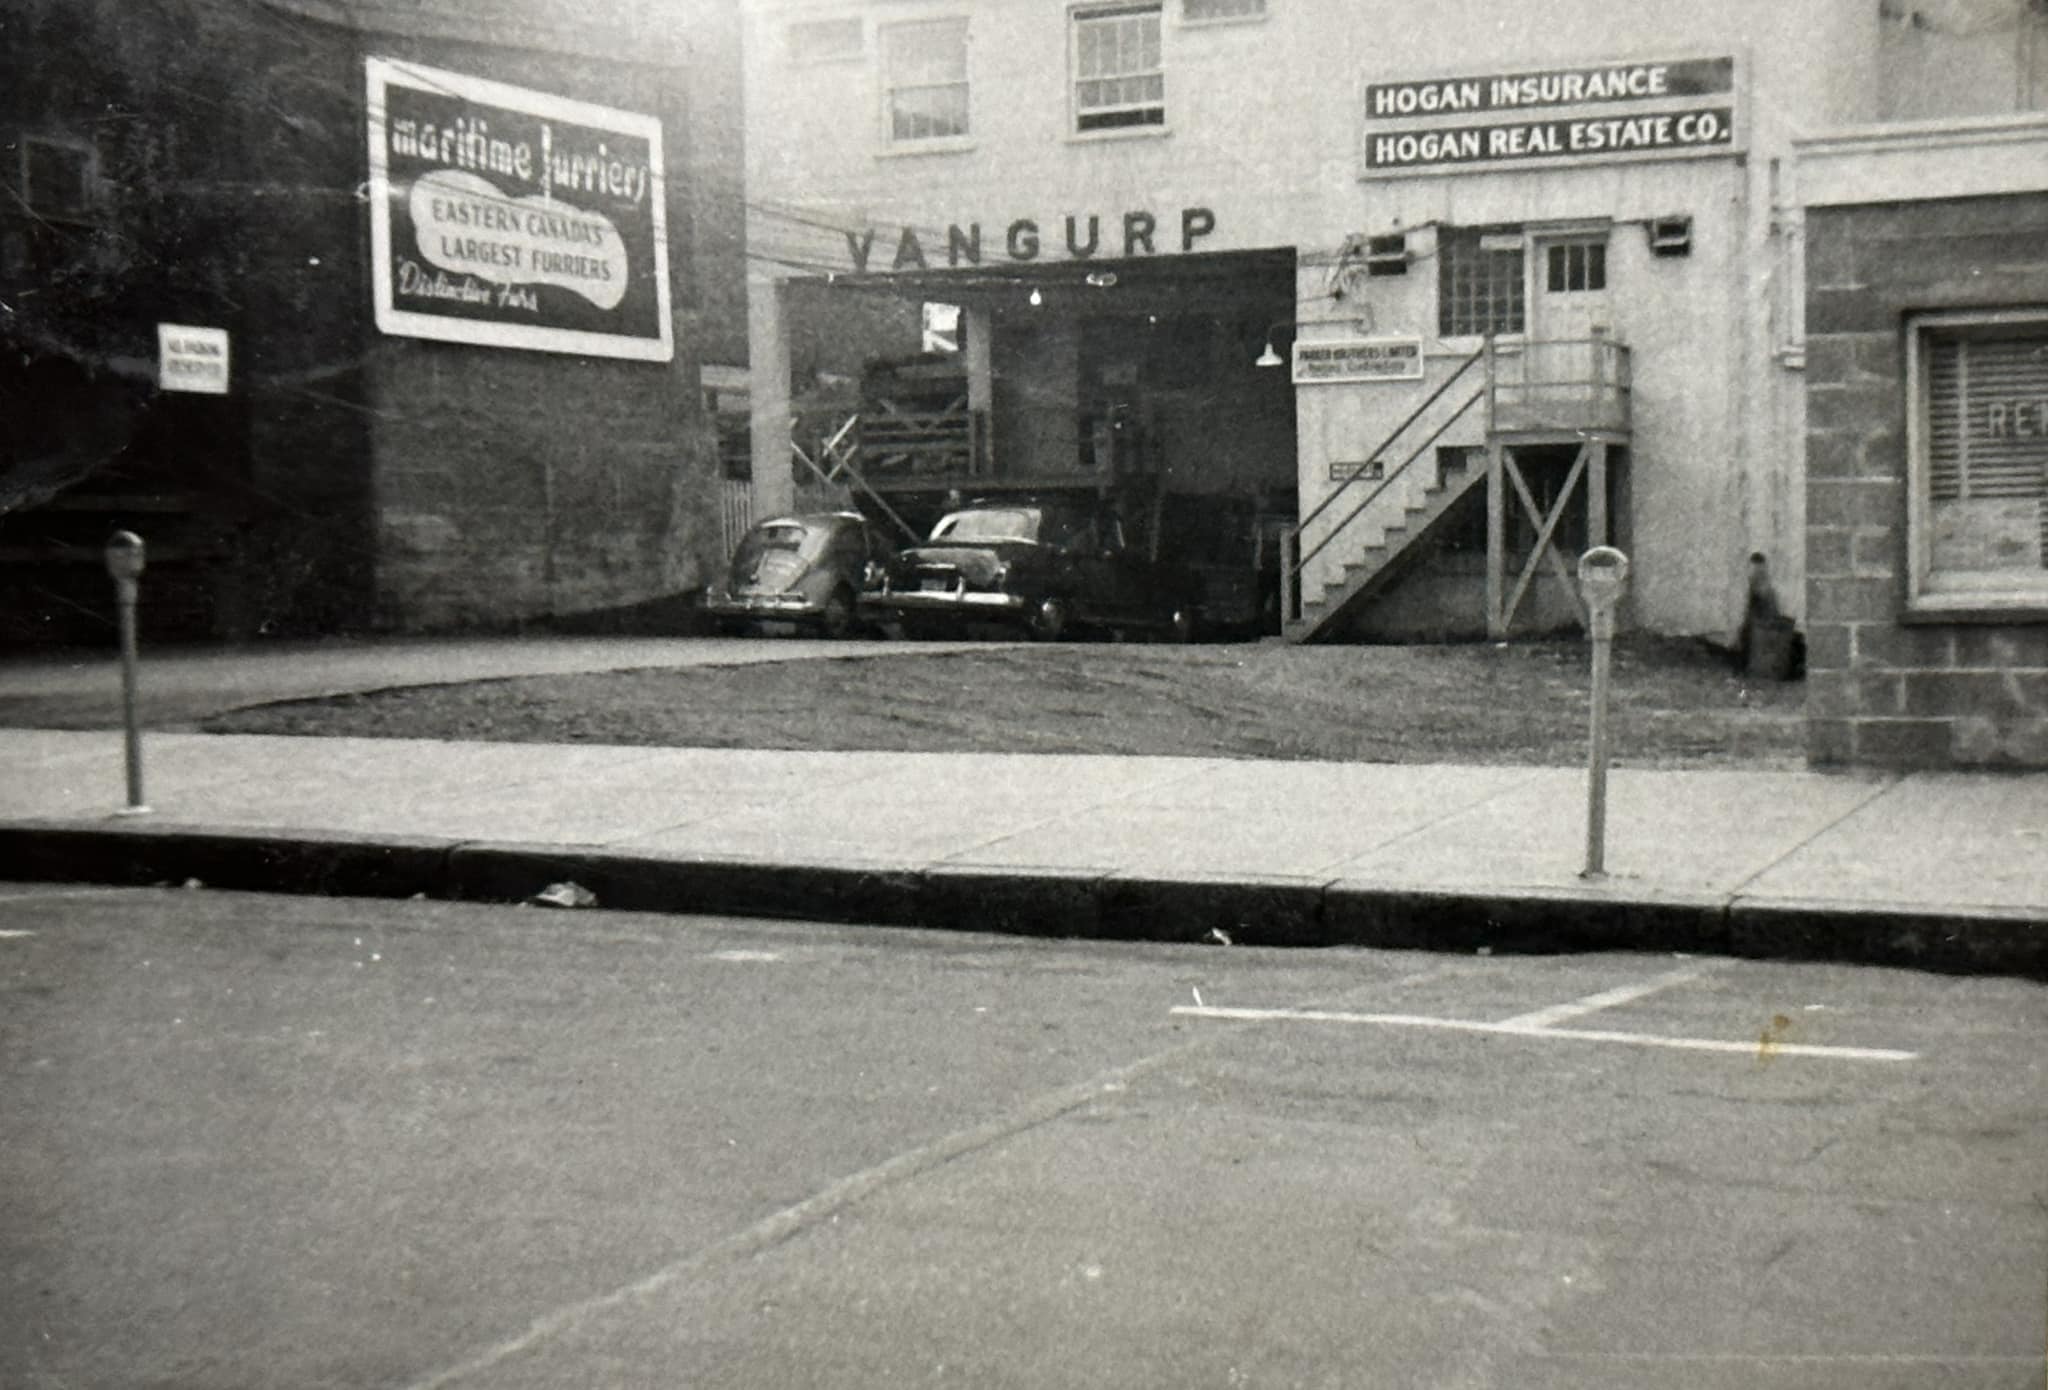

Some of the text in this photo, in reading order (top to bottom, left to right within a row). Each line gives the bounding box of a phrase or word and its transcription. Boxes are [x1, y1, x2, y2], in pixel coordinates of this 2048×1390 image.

[1375, 66, 1668, 114] HOGAN INSURANCE
[392, 117, 647, 204] maritime furriers
[1375, 113, 1729, 164] HOGAN REAL ESTATE CO.
[432, 197, 520, 233] EASTERN
[440, 234, 612, 281] LARGEST FURRIERS
[845, 207, 1216, 273] VANGURP
